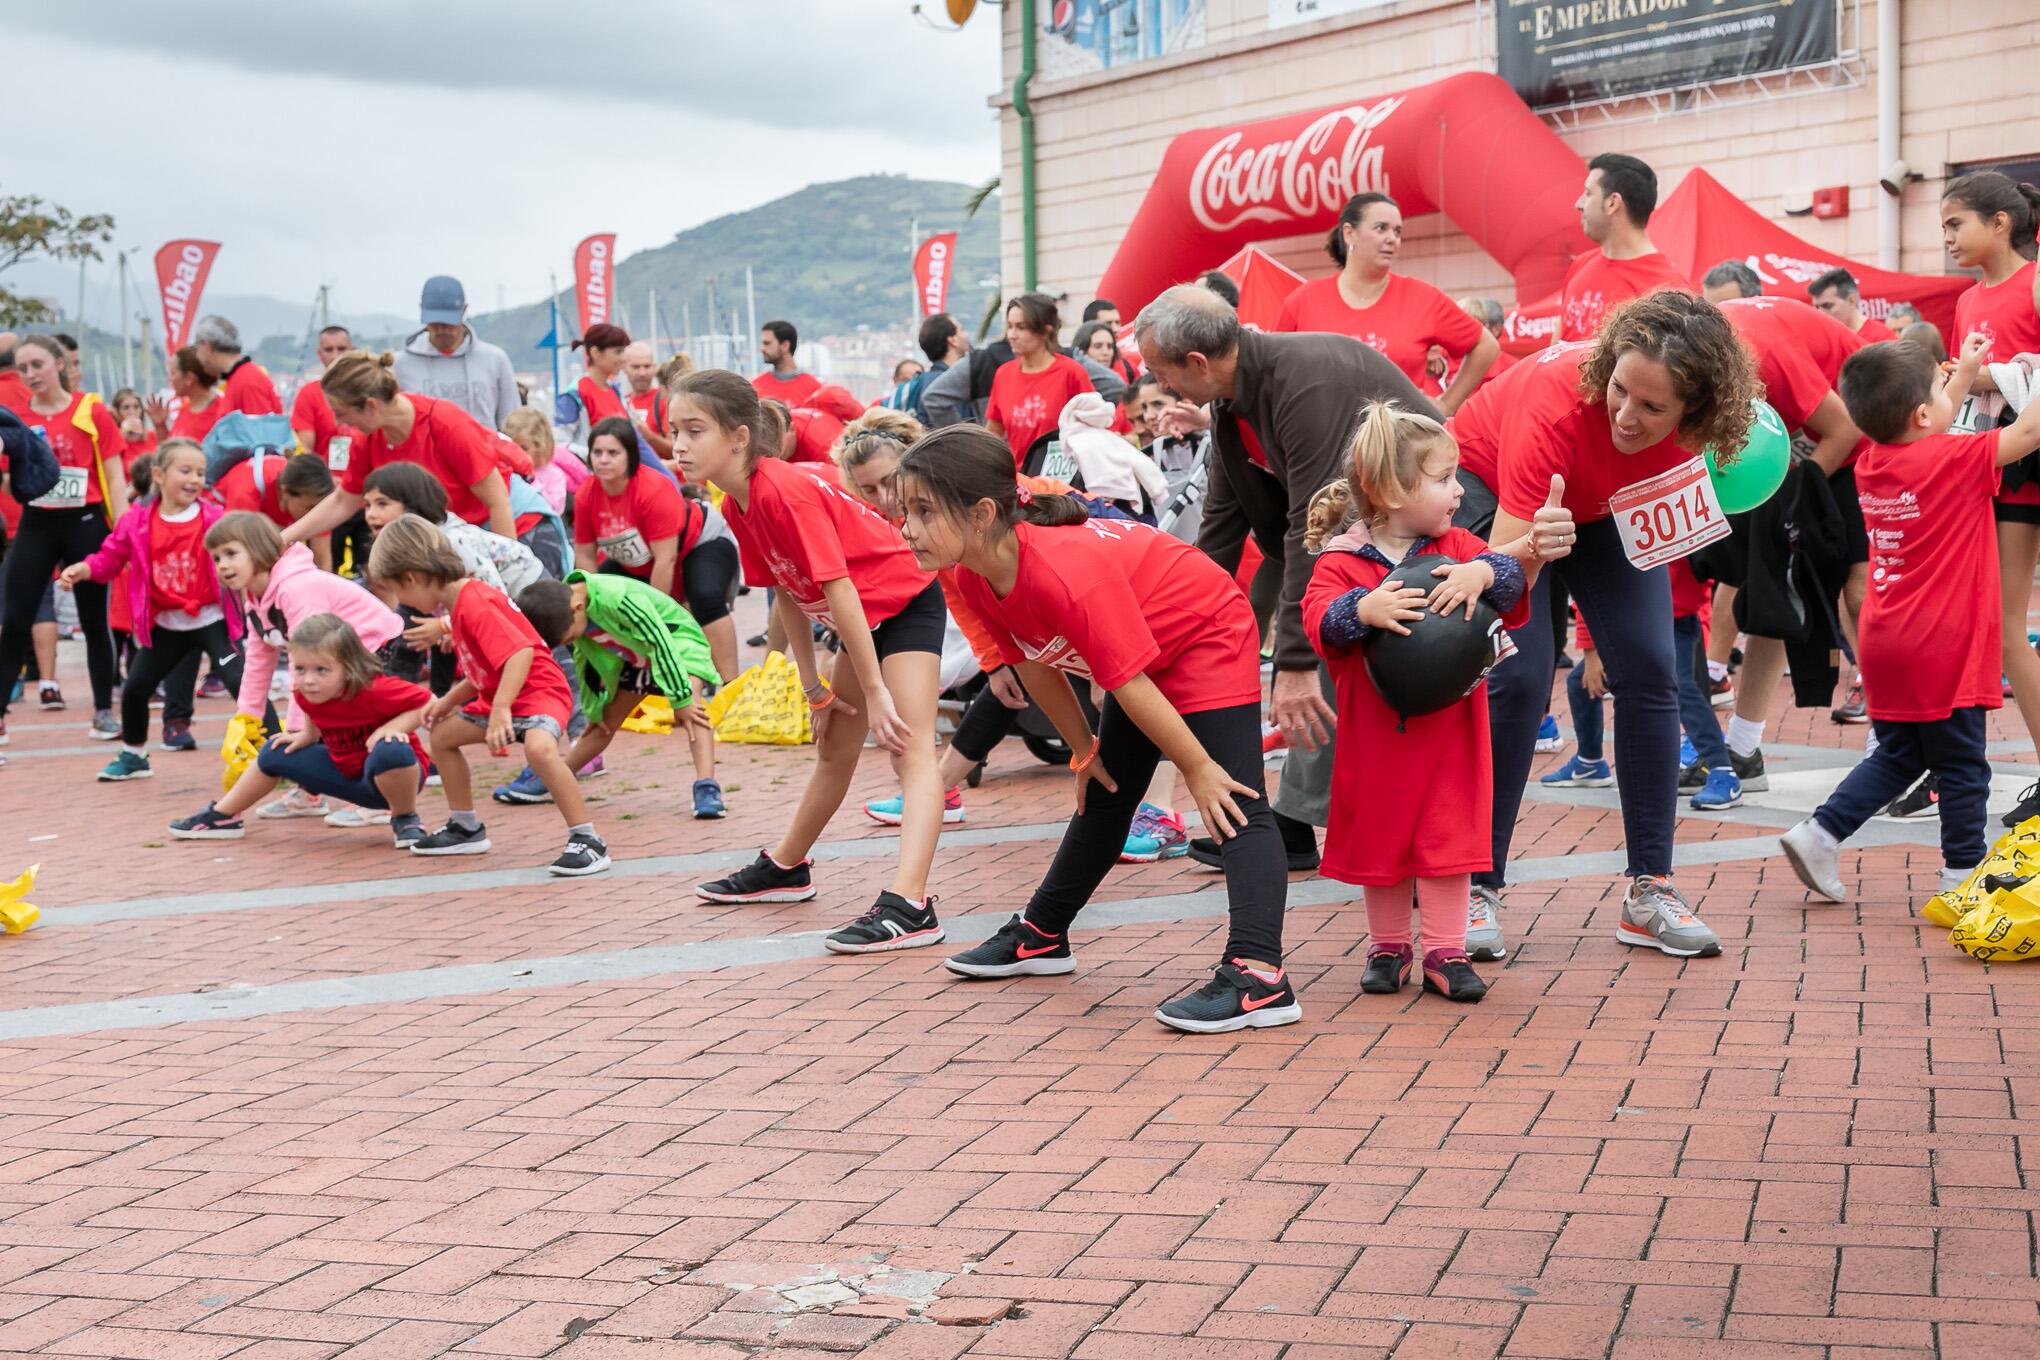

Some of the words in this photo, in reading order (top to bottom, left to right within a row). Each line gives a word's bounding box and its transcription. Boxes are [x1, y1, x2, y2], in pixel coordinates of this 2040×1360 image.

[926, 241, 947, 315] ilbao
[1516, 315, 1561, 339] Segur
[1630, 484, 1710, 550] 3014
